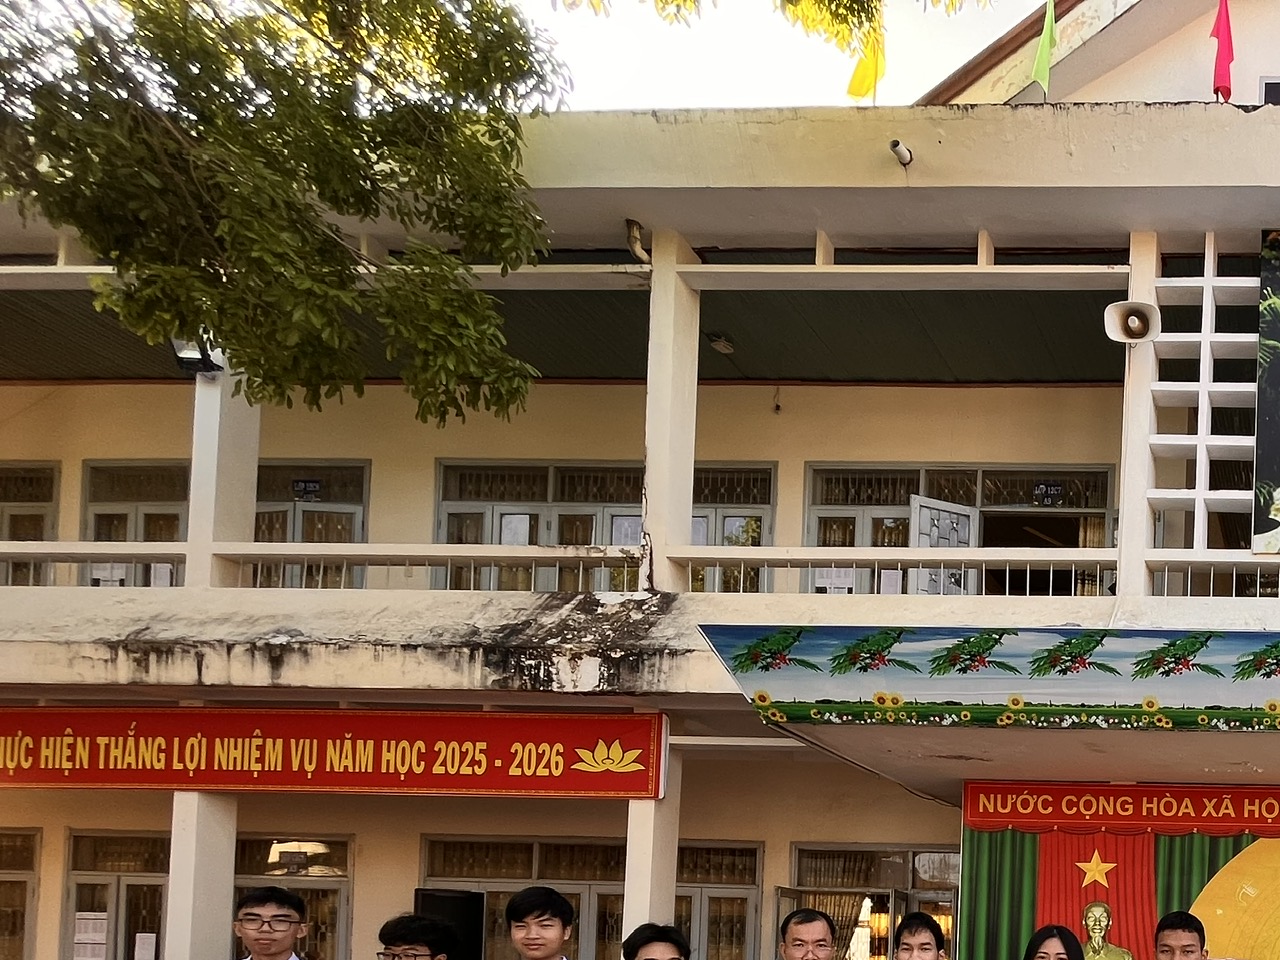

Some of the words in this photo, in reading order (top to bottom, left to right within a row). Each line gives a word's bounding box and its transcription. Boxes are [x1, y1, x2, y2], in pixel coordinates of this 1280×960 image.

[40, 727, 90, 776] HIỆN
[96, 721, 166, 770] THẮNG
[172, 732, 206, 777] LỢI
[213, 729, 283, 779] NHIỆM
[289, 736, 318, 780] VỤ
[325, 732, 374, 773] NĂM
[380, 738, 426, 781] HỌC
[432, 740, 487, 776] 2025
[508, 742, 564, 777] 2026
[979, 790, 1053, 814] NƯỚC
[1061, 794, 1134, 820] CỘNG
[1142, 793, 1196, 817] HÒA
[1201, 794, 1236, 818] XÃ
